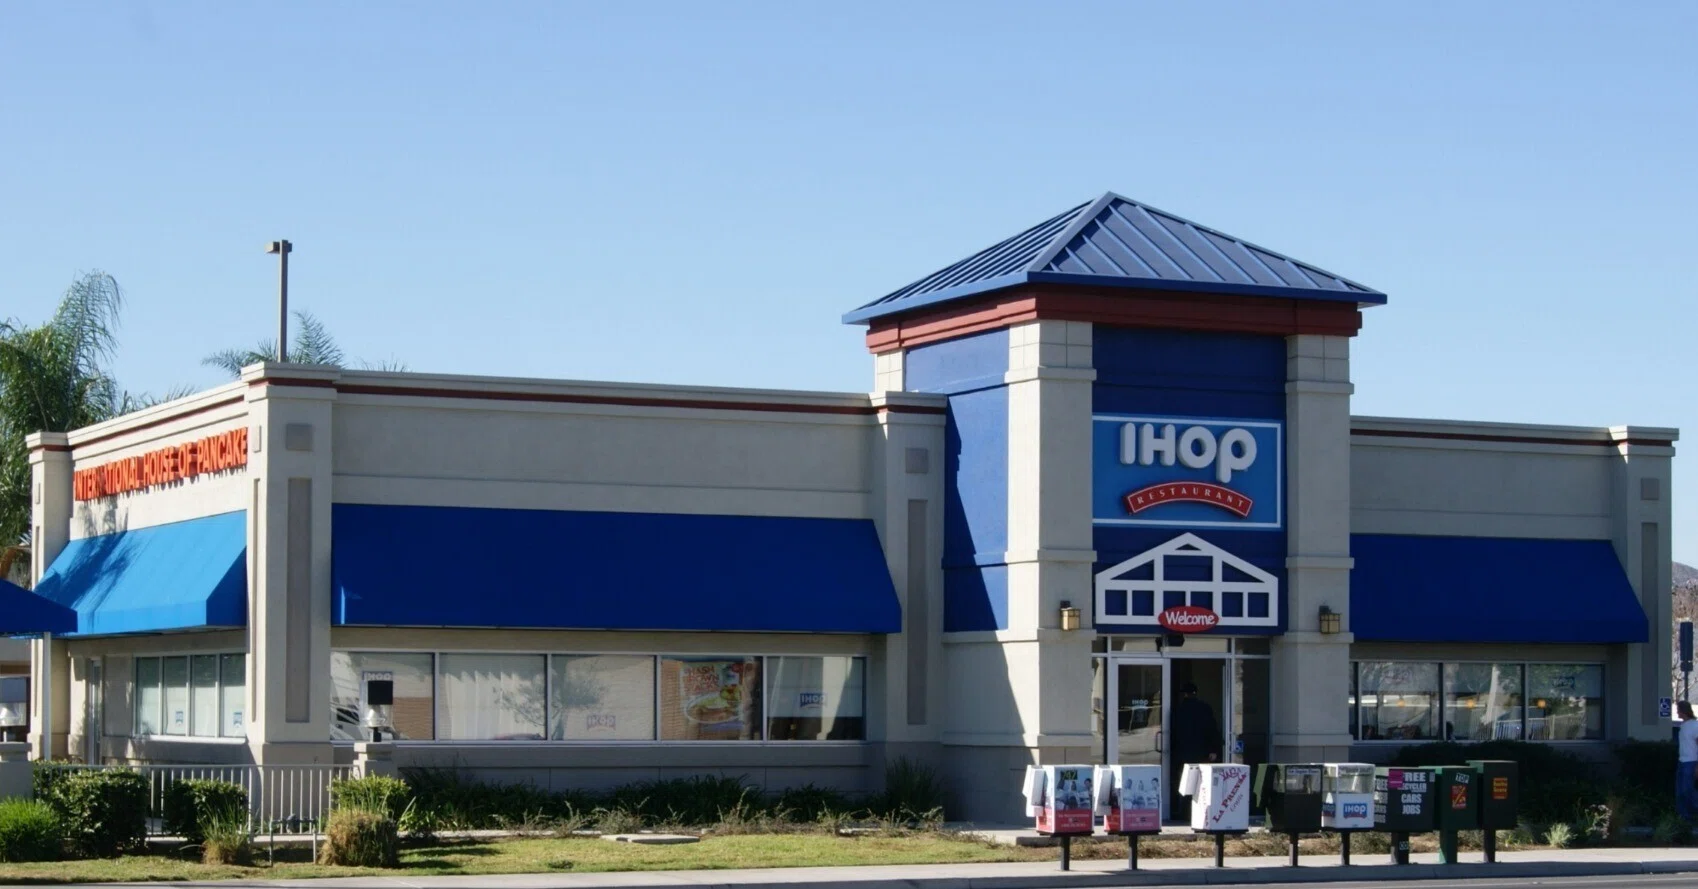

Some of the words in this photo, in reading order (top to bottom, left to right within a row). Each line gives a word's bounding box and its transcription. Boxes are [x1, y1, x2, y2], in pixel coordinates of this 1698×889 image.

[1120, 422, 1257, 483] IHOP
[75, 456, 140, 501] INTERNATIONAL
[144, 446, 175, 487] HOUSE
[179, 442, 193, 478] OF
[1136, 486, 1244, 507] RESTAURANT
[1165, 611, 1215, 626] Welcome
[1401, 793, 1422, 804] CARS
[1212, 809, 1225, 823] LA
[1344, 804, 1366, 814] IHOP
[1402, 805, 1421, 815] JOBS
